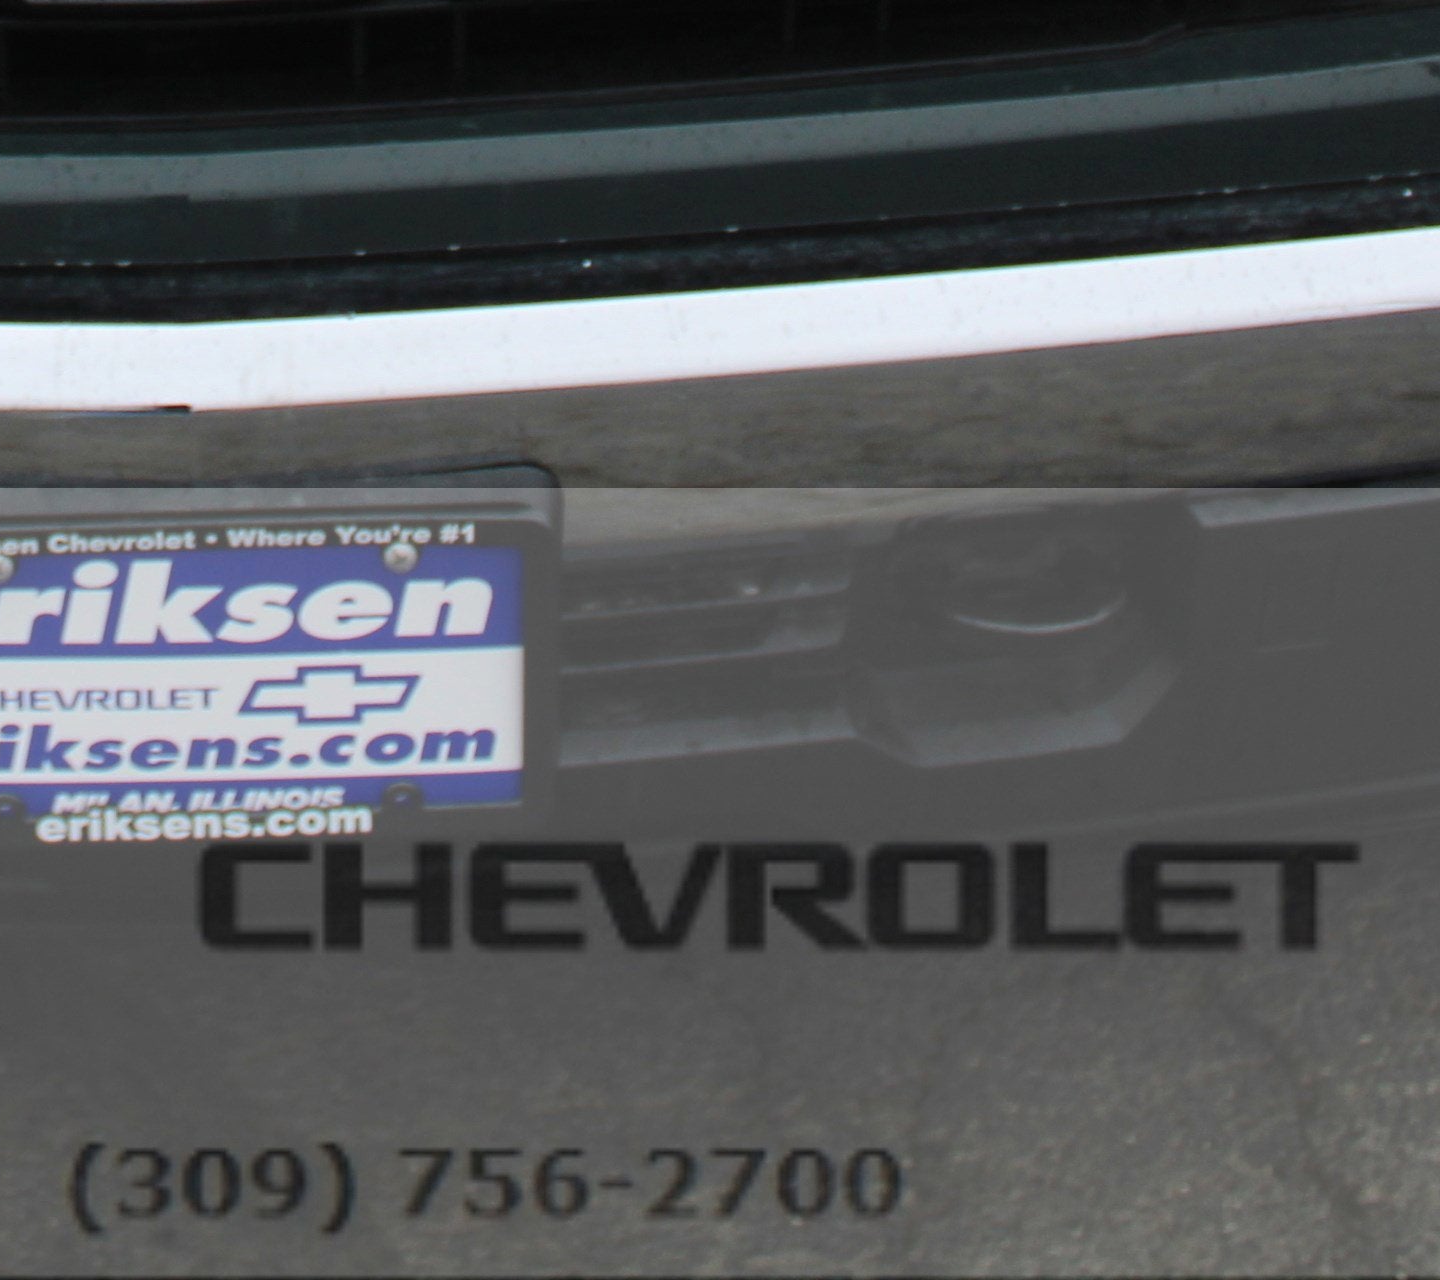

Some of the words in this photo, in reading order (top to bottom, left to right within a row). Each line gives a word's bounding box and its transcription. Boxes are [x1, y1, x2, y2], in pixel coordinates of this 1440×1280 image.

[47, 530, 196, 554] Chevrolet
[227, 526, 326, 548] Where
[334, 523, 432, 545] You're
[439, 523, 476, 544] #1
[187, 786, 346, 811] ILLINOIS
[36, 806, 373, 842] eriksens.com
